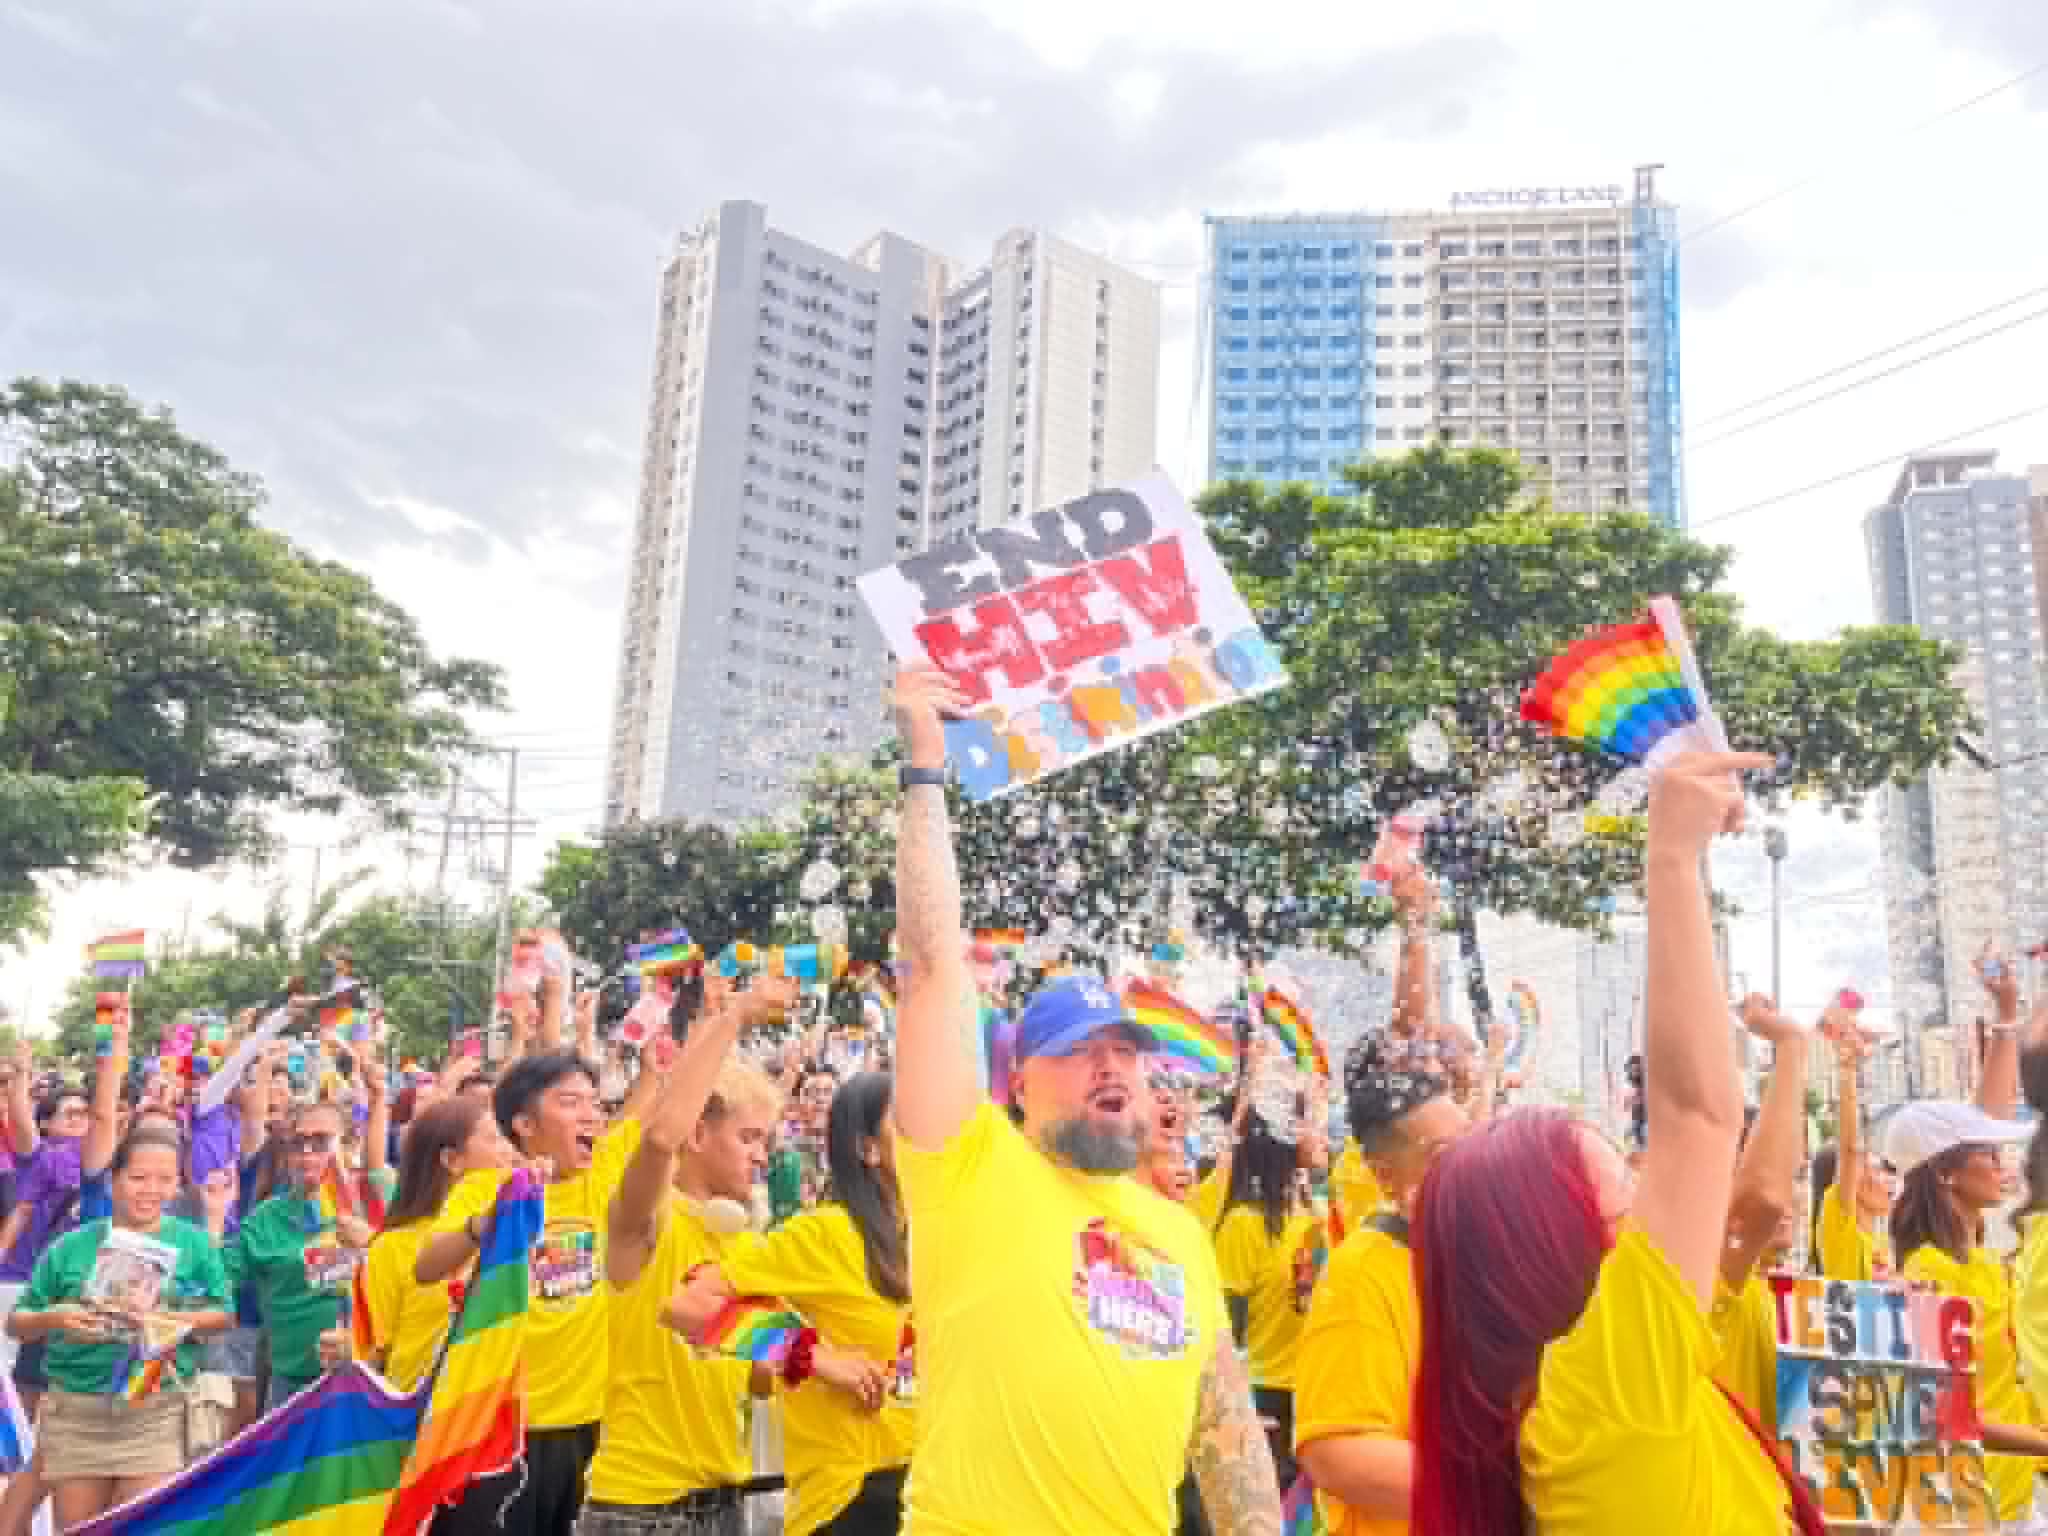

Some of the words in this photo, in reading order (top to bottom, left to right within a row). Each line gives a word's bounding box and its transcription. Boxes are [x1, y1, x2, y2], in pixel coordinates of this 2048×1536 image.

[1559, 184, 1624, 203] LAND
[899, 488, 1154, 616] END
[913, 534, 1200, 704] HIV
